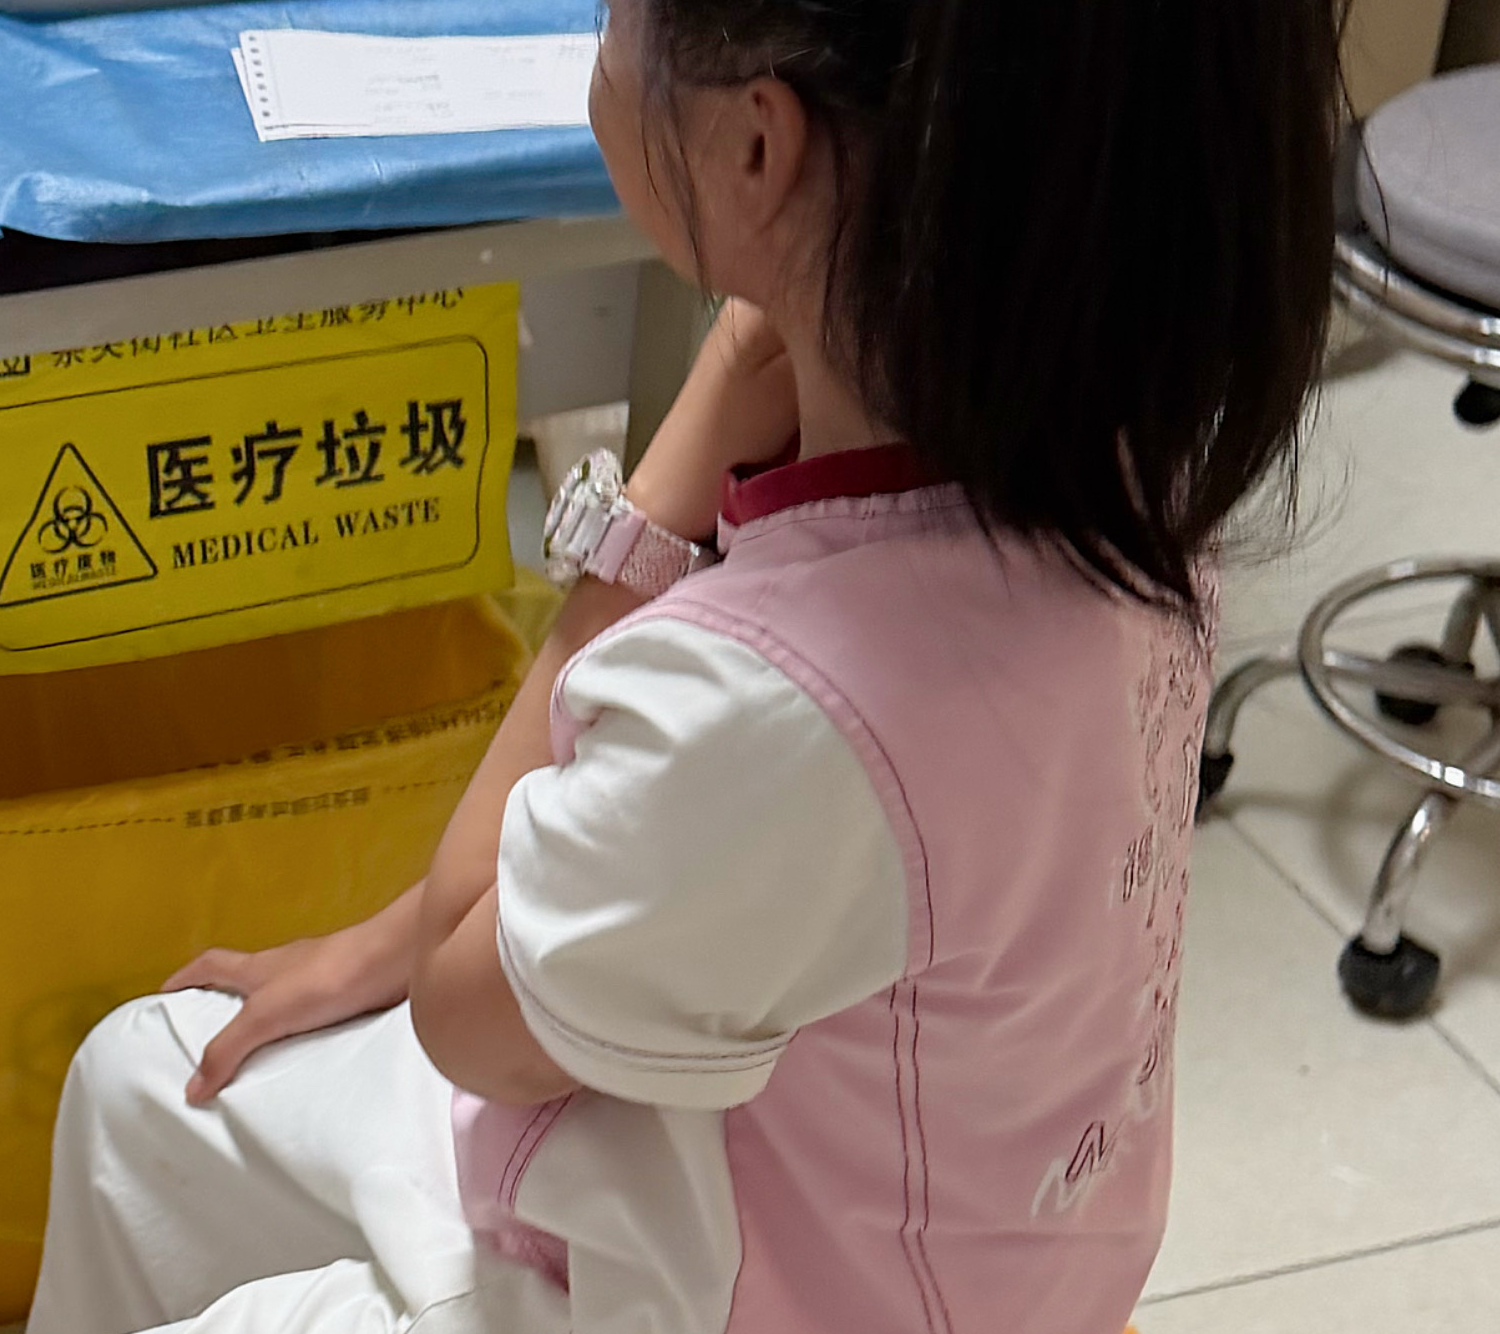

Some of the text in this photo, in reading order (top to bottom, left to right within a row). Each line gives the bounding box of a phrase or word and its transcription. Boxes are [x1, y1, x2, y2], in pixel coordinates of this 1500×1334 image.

[147, 399, 466, 519] 医疗垃圾
[172, 497, 440, 568] MEDICAL WASTE
